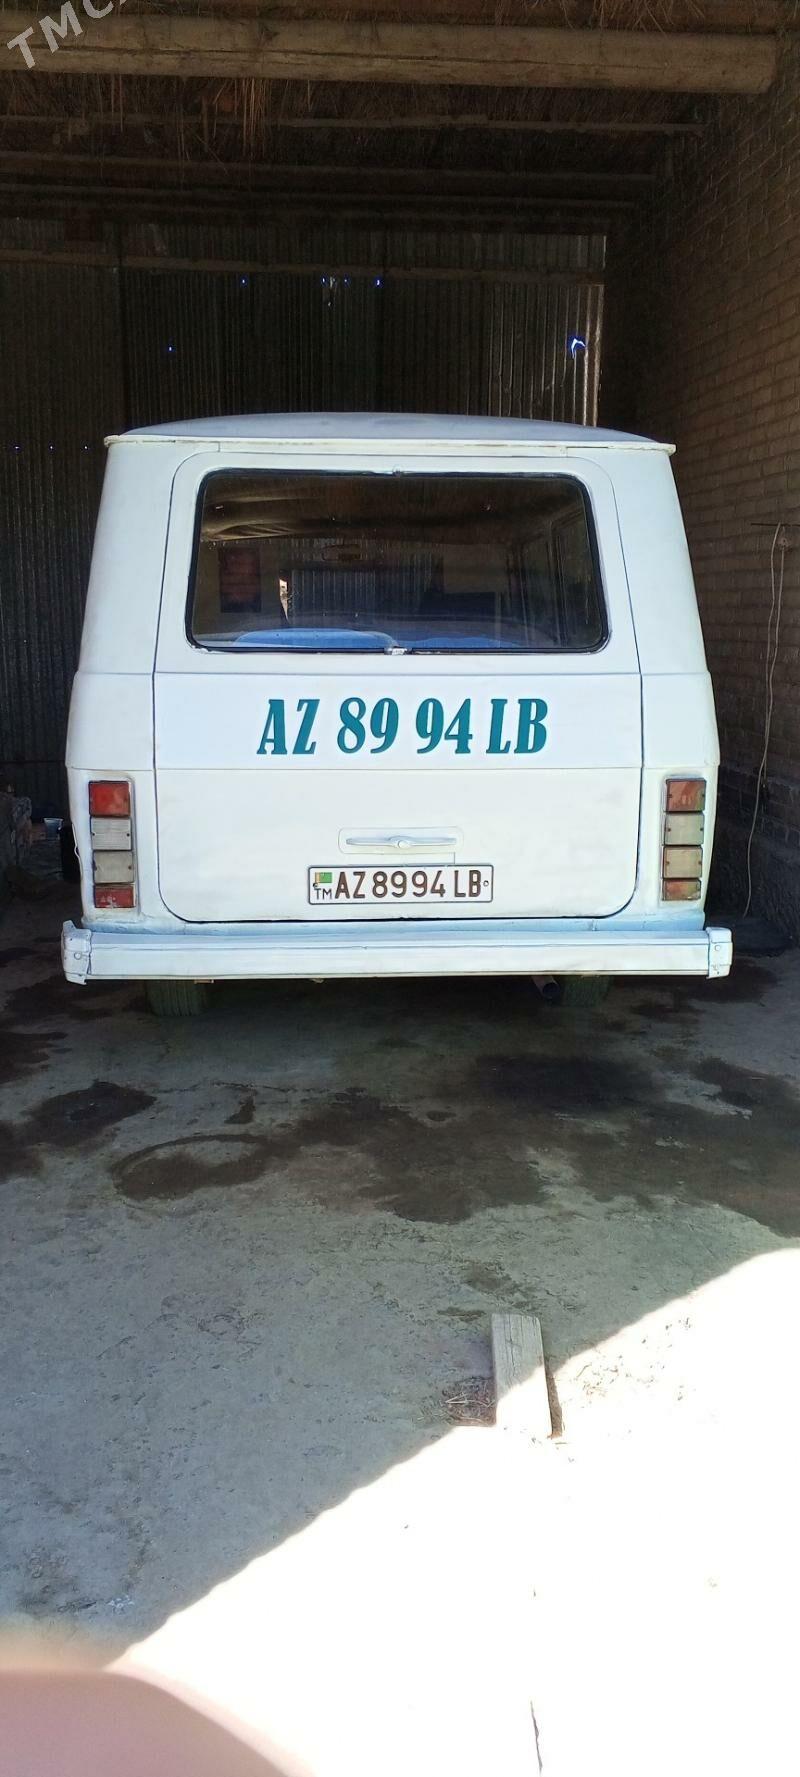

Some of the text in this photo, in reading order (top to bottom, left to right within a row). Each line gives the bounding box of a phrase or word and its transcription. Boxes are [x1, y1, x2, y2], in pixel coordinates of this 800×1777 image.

[257, 697, 547, 754] AZ 89 94 LB
[314, 887, 332, 899] TM
